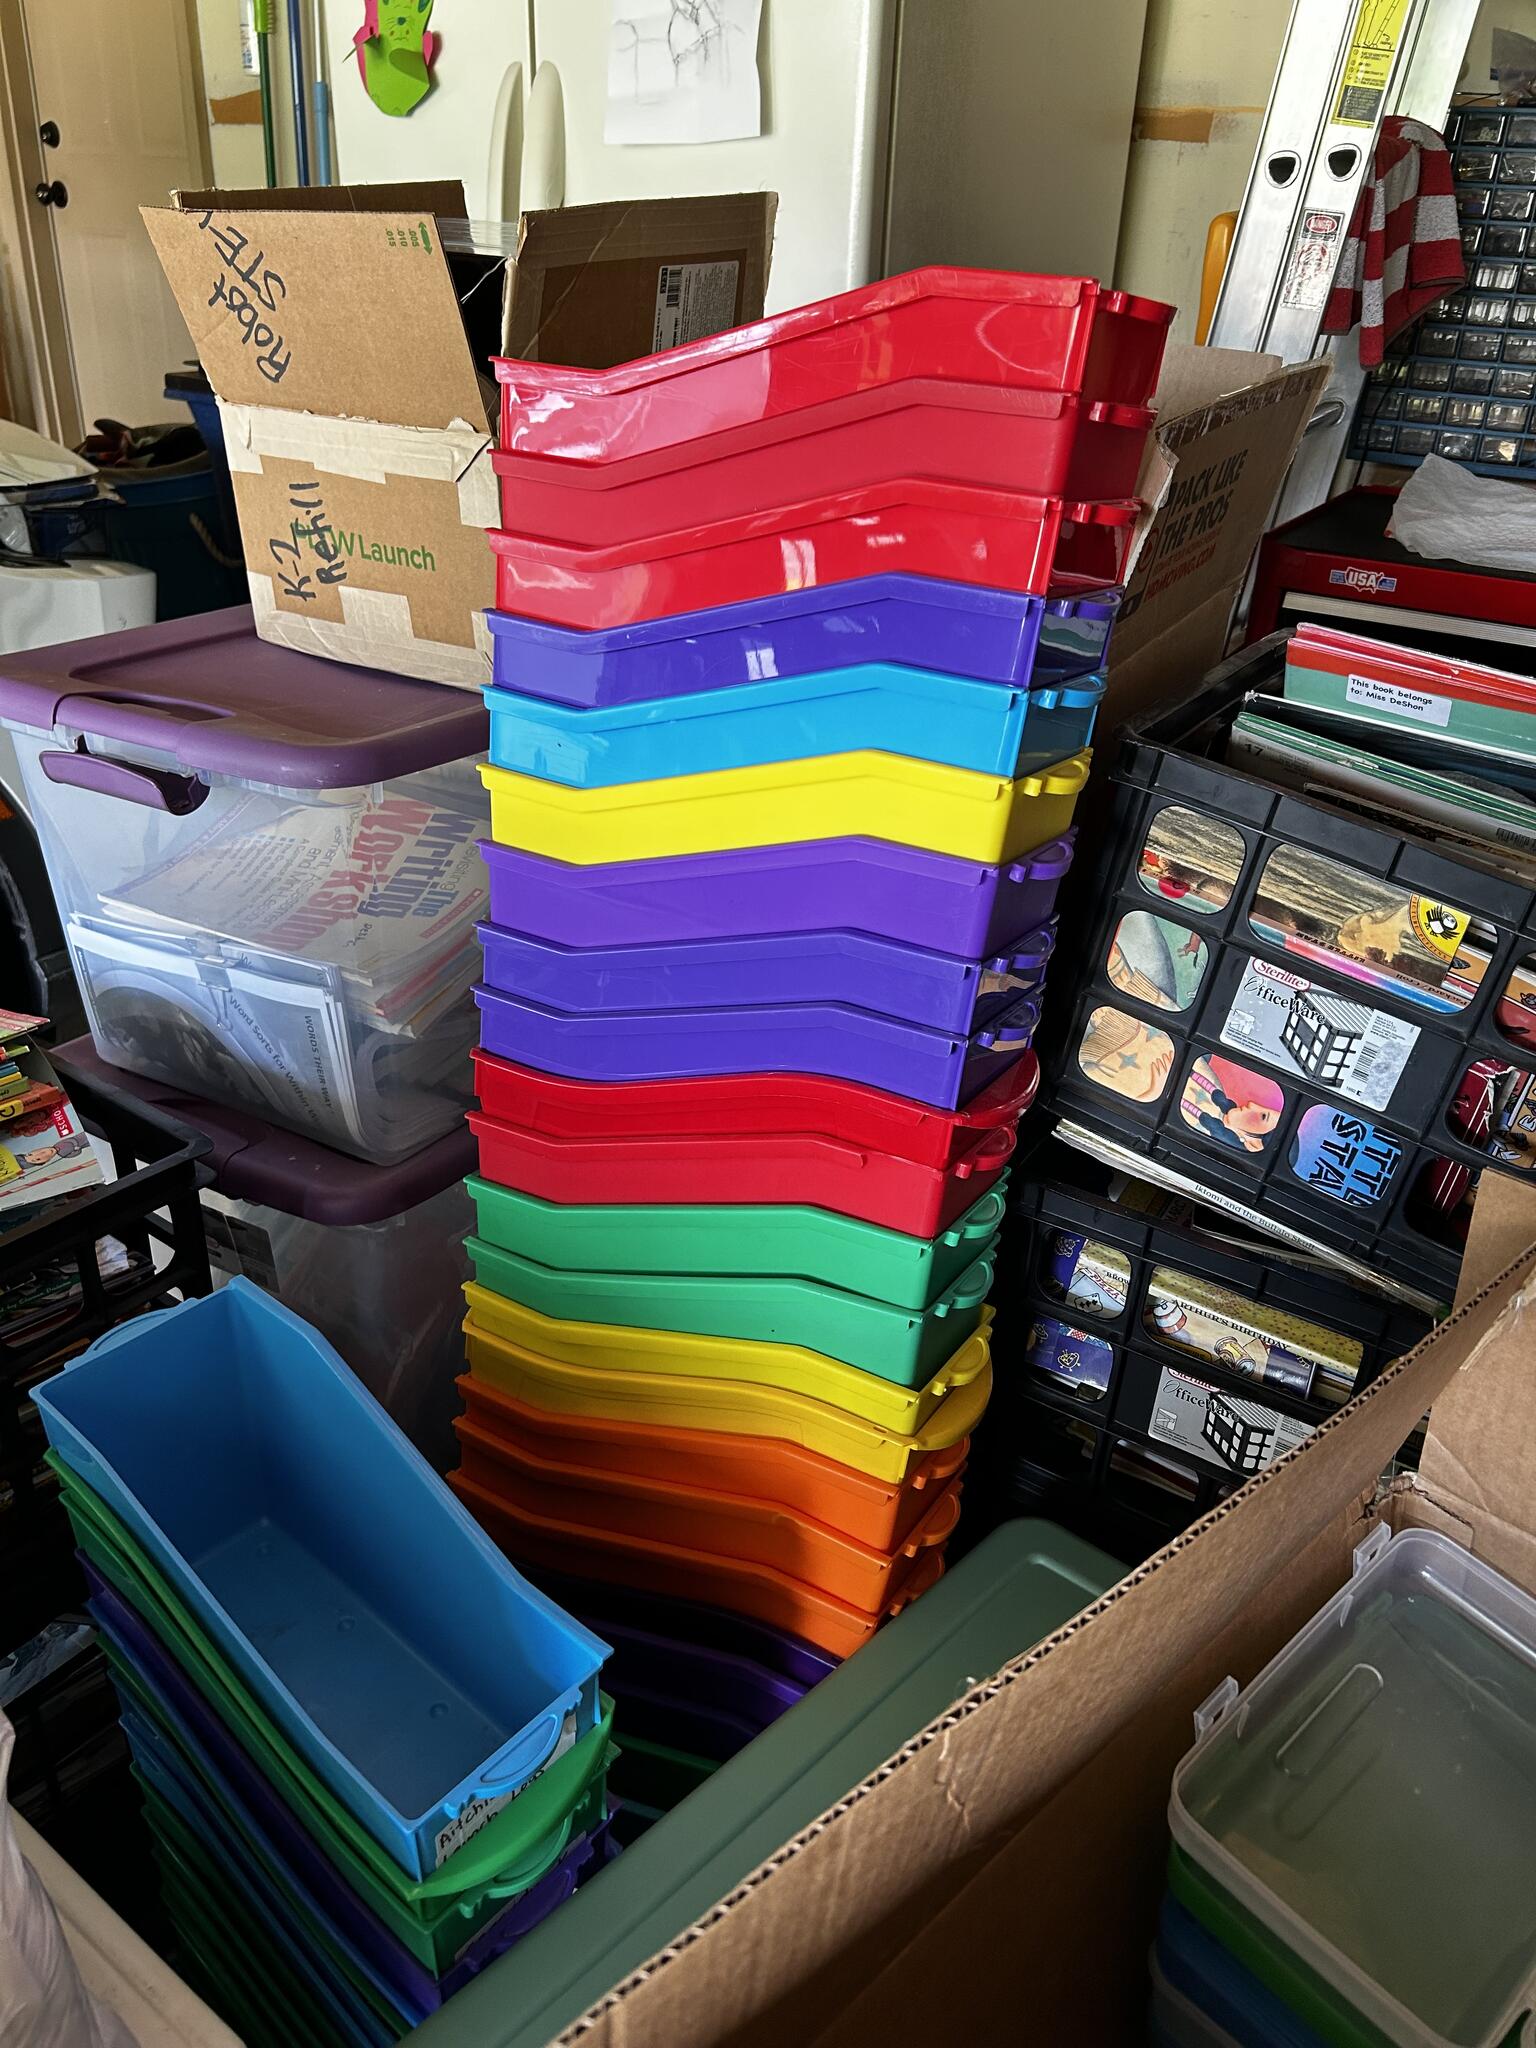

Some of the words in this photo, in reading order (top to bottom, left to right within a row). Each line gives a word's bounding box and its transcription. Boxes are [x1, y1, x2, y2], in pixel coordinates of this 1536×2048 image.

[1170, 464, 1217, 517] PACK
[1215, 449, 1248, 493] LIKE
[1160, 511, 1193, 558] THE
[1192, 489, 1234, 538] PROS
[358, 534, 436, 572] Launch
[1348, 571, 1377, 588] USA
[1350, 687, 1363, 696] to:
[1366, 691, 1386, 701] Miss
[1390, 697, 1424, 711] DeShon
[1351, 678, 1369, 688] This
[1373, 683, 1394, 694] book
[1398, 690, 1432, 705] belongs
[358, 812, 481, 919] Writing
[440, 846, 478, 891] evisiting
[412, 889, 460, 918] The
[1257, 959, 1302, 987] Sterilite
[1244, 975, 1326, 1025] OfficeWare
[229, 995, 253, 1026] Word
[252, 1024, 274, 1055] Sorts
[272, 1053, 286, 1072] for
[304, 1014, 318, 1055] WORDS
[314, 1056, 326, 1085] THEIR
[1309, 1113, 1367, 1191] STA
[1195, 1183, 1223, 1204] Iktomi
[1224, 1200, 1242, 1214] and
[1242, 1208, 1258, 1221] the
[1091, 1271, 1120, 1299] PIZZA
[1231, 1322, 1290, 1352] BIRTHDAY
[1162, 1380, 1240, 1423] OfficeWare
